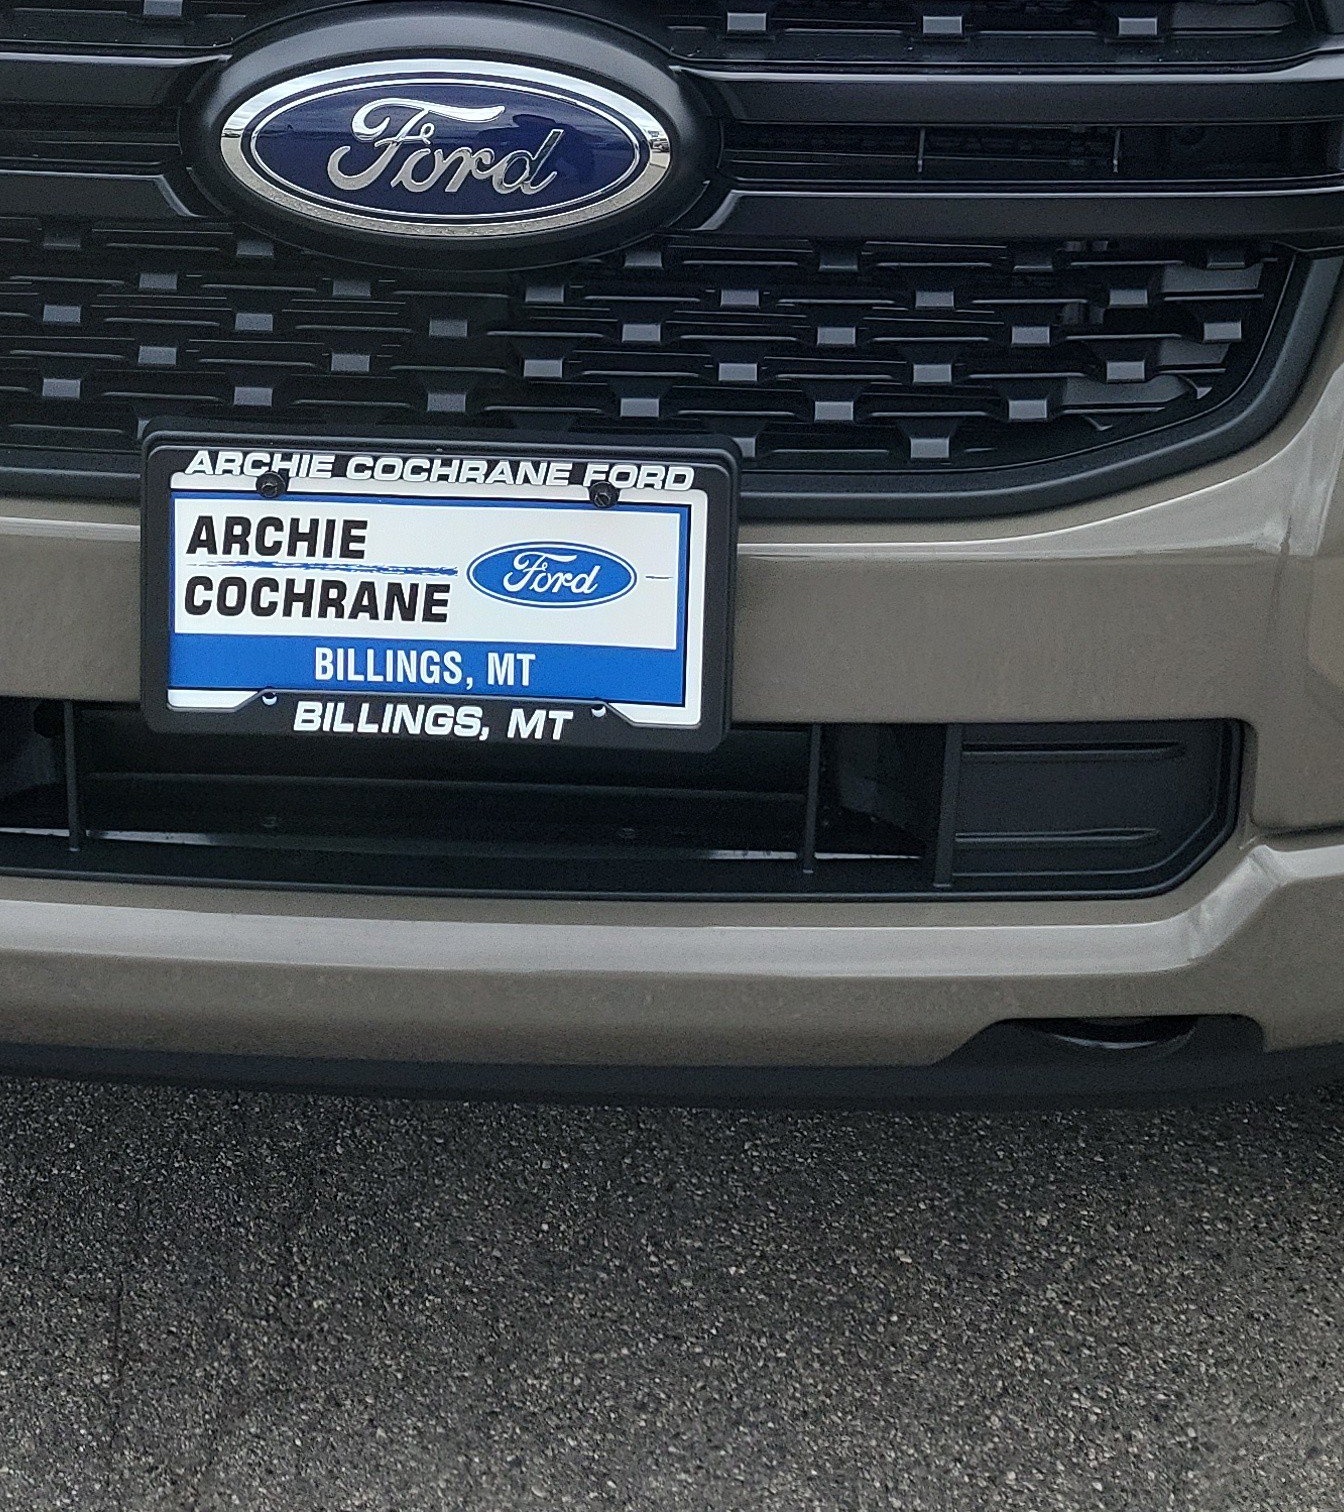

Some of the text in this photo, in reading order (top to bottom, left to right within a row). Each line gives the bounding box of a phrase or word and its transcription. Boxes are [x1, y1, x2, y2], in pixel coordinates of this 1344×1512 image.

[327, 96, 565, 196] Ford
[183, 450, 696, 491] ARCHIE COCHRANE FORD
[186, 514, 369, 561] ARCHIE
[502, 550, 600, 596] Ford
[183, 575, 452, 624] COCHRANE
[314, 646, 537, 690] BILLINGS, MT
[292, 700, 574, 742] BILLINGS, MT
